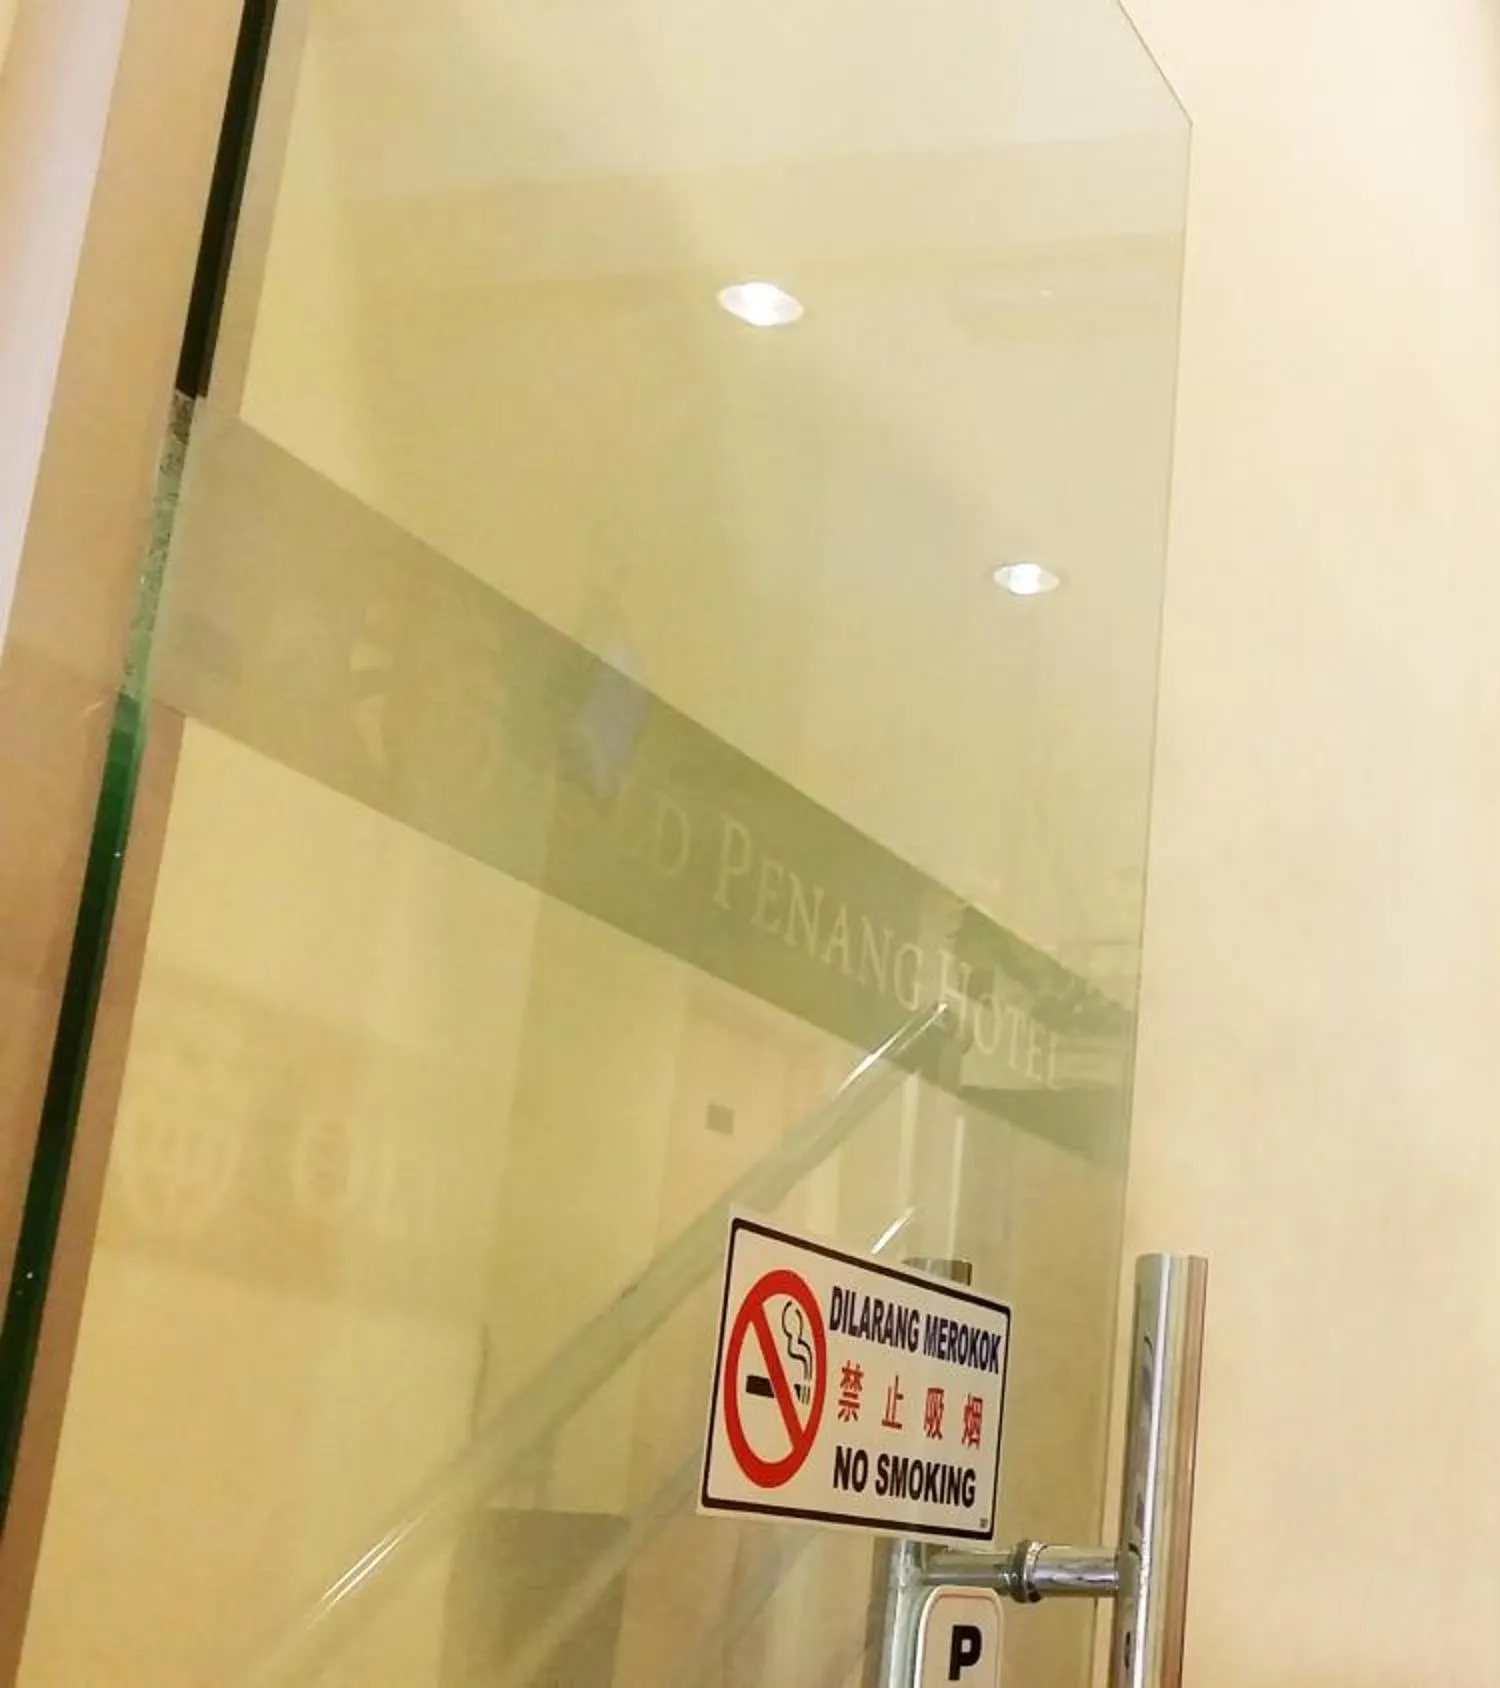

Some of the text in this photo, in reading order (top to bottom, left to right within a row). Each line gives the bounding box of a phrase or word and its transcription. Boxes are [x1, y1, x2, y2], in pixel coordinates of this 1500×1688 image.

[712, 811, 923, 1013] PENANG
[936, 947, 1066, 1093] HOTEL
[828, 1284, 1001, 1376] DILARANG MEROKOK
[837, 1359, 984, 1451] 禁止吸烟
[833, 1444, 978, 1509] NO SMOKING
[947, 1624, 983, 1681] P
